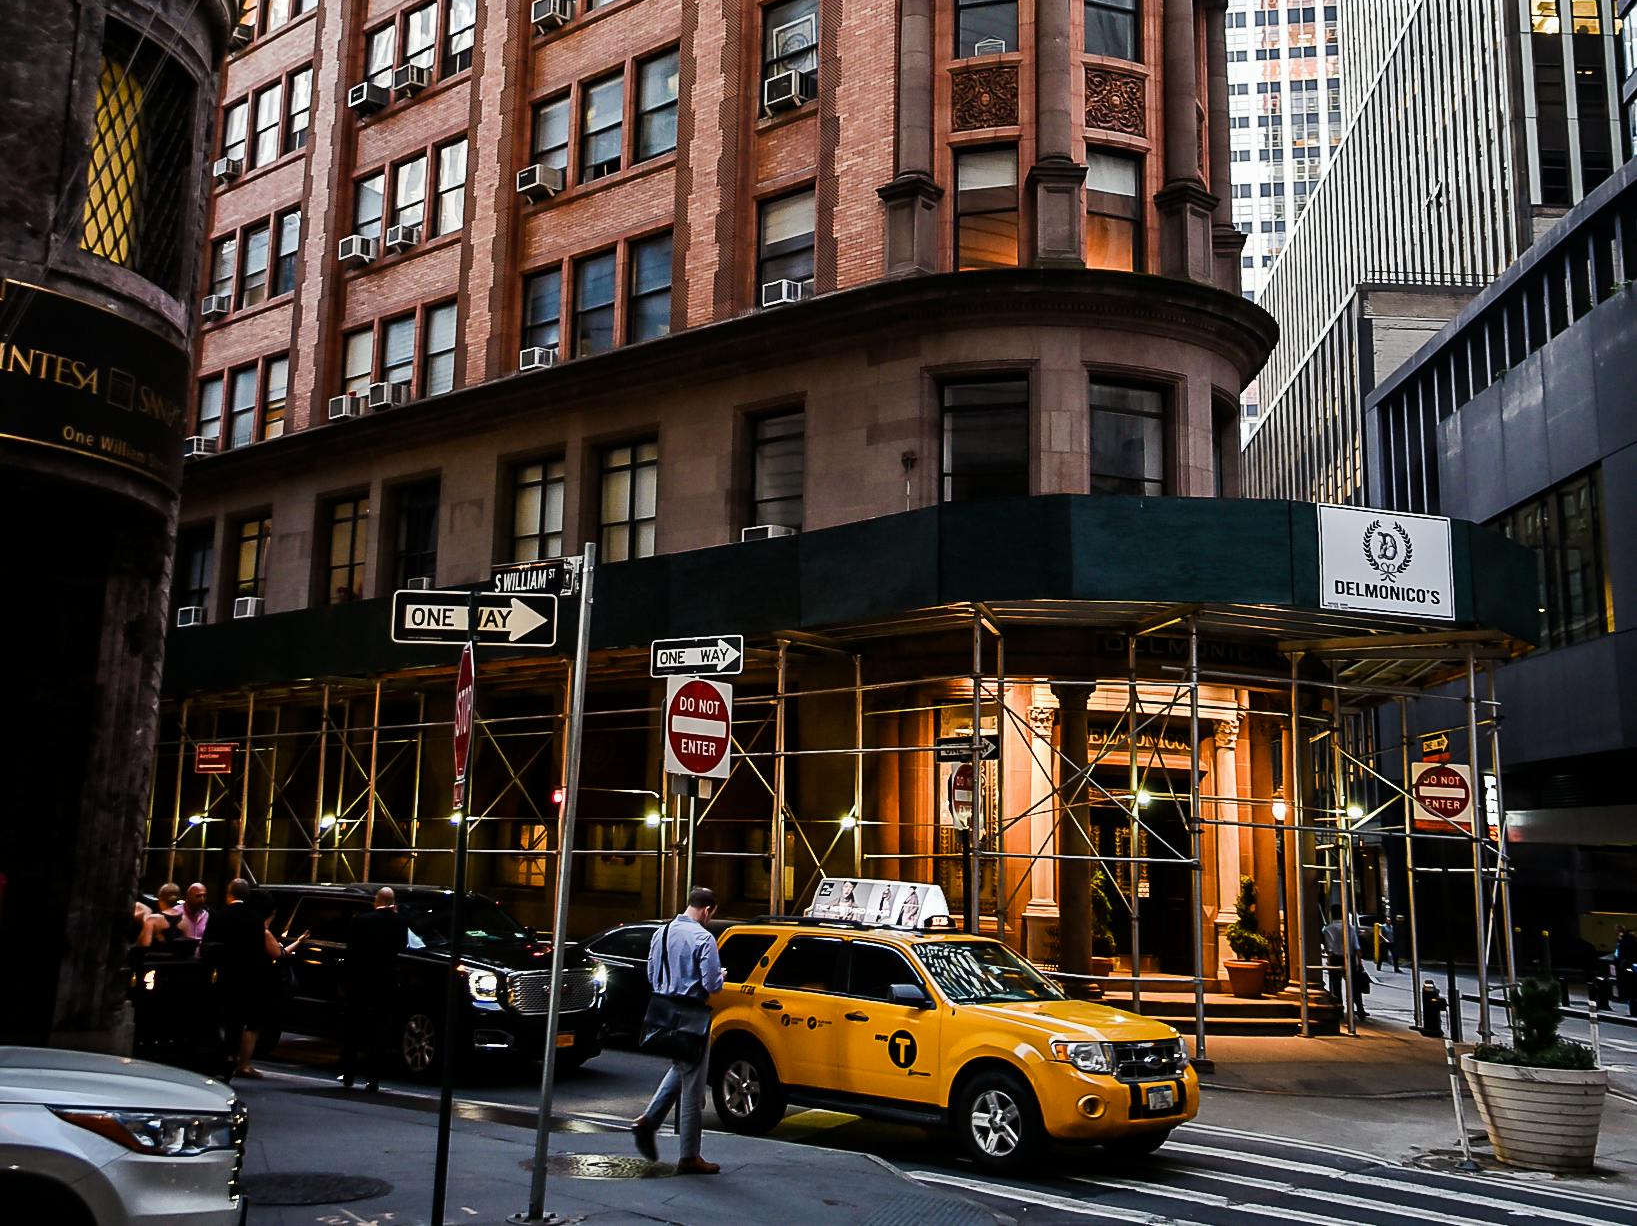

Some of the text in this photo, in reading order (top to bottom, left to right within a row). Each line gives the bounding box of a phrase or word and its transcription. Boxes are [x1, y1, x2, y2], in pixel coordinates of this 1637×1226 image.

[0, 342, 99, 395] INTESA
[63, 425, 95, 447] One
[494, 574, 502, 593] S
[503, 569, 547, 592] WILLIAM
[548, 568, 556, 579] ST
[1335, 579, 1441, 605] DELMONICO'S
[411, 607, 455, 627] ONE
[660, 647, 729, 665] ONE WAY
[680, 696, 720, 715] DO NOT
[681, 738, 716, 756] ENTER
[1441, 776, 1460, 785] NOT
[1425, 798, 1461, 809] ENTER
